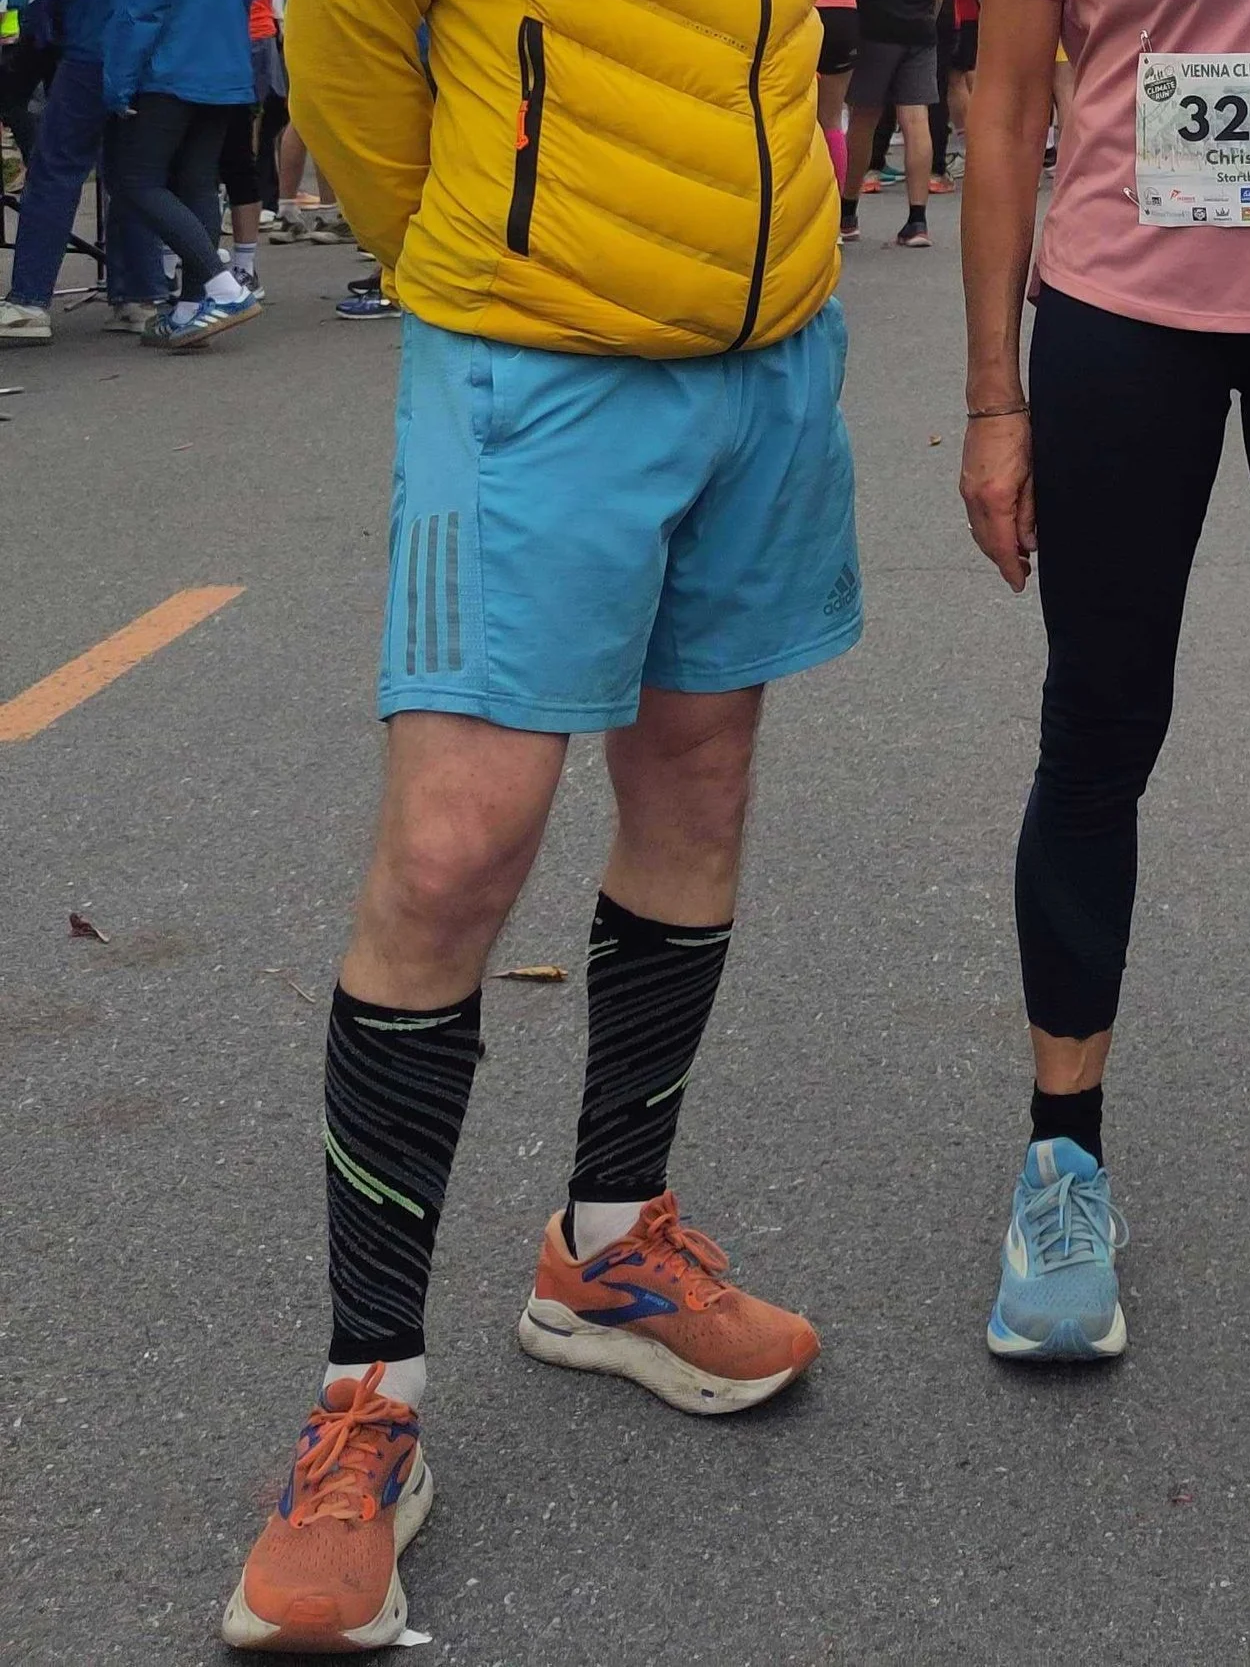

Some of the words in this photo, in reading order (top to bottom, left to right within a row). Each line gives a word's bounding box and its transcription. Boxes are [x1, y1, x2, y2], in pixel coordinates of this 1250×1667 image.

[1181, 63, 1230, 78] VIENNA
[1146, 82, 1176, 96] CLIMATE
[1154, 91, 1172, 100] RUN
